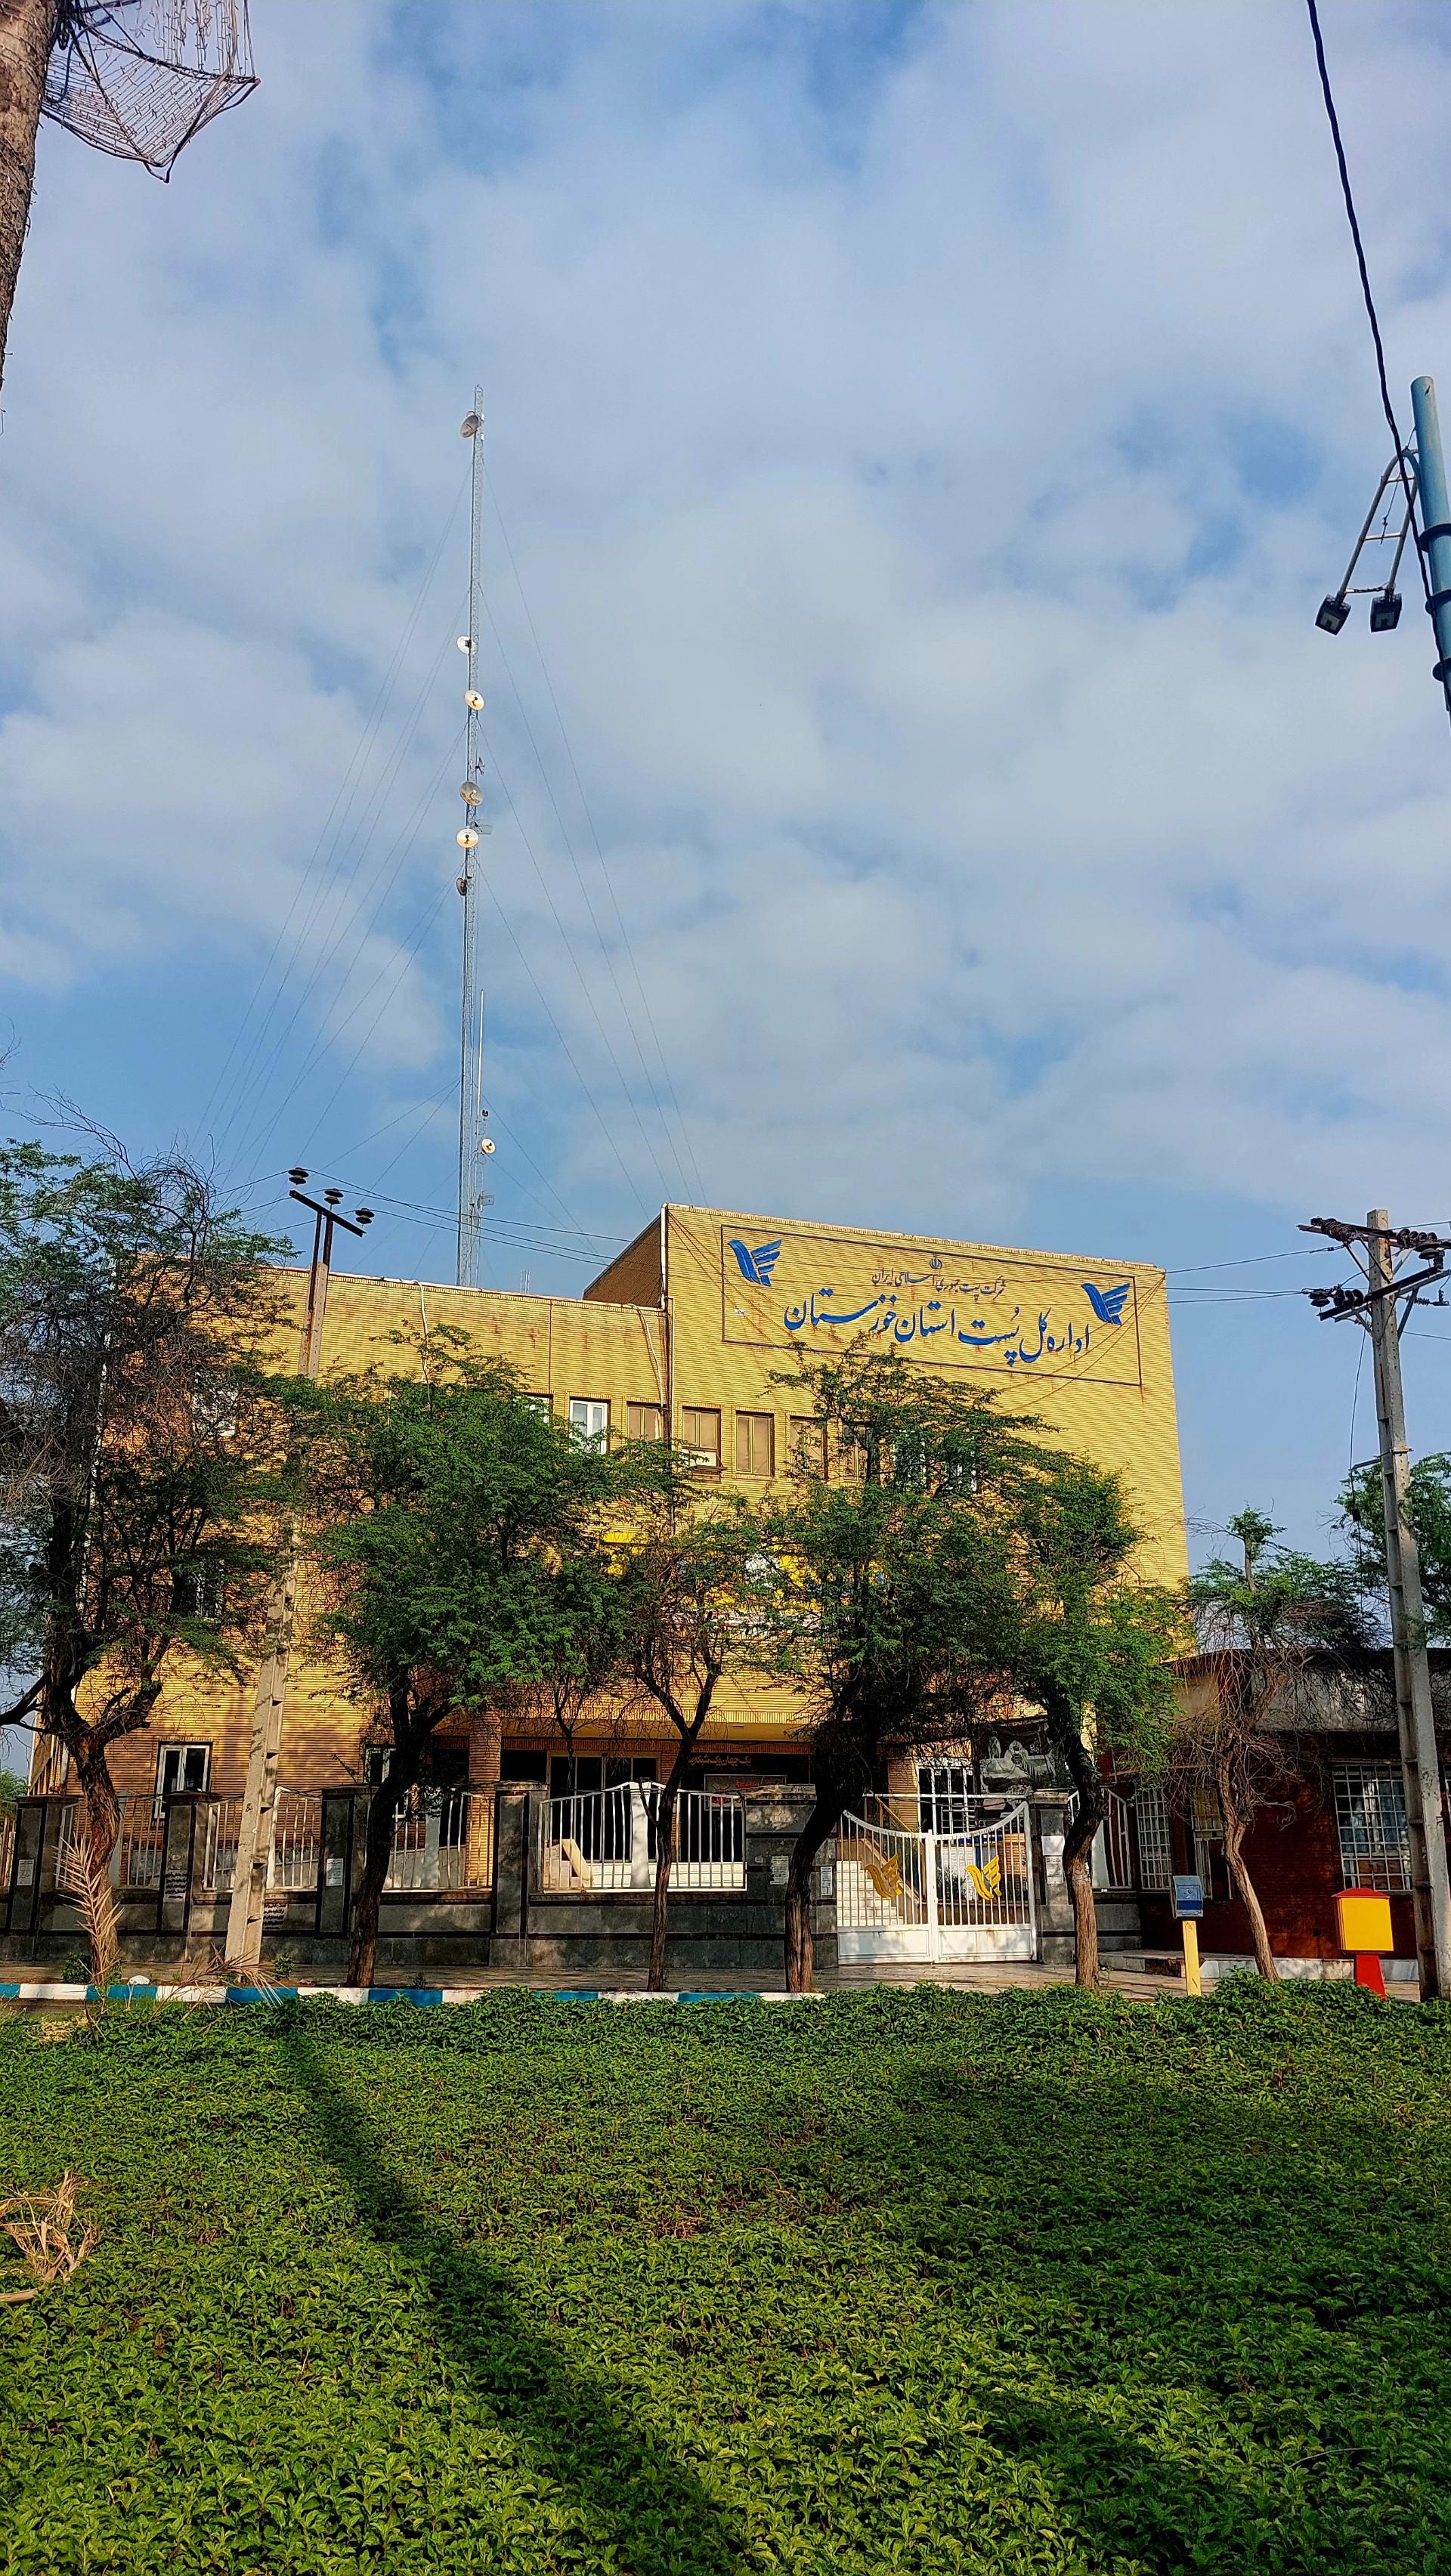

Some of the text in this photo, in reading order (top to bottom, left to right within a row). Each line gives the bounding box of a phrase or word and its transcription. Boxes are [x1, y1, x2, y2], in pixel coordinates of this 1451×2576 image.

[871, 1268, 1006, 1302] شرکت پست جمهوری اسلامی ایران
[784, 1288, 898, 1331] خوزستان
[894, 1300, 955, 1343] استان
[1019, 1307, 1052, 1363] کل
[1047, 1322, 1090, 1354] اداره
